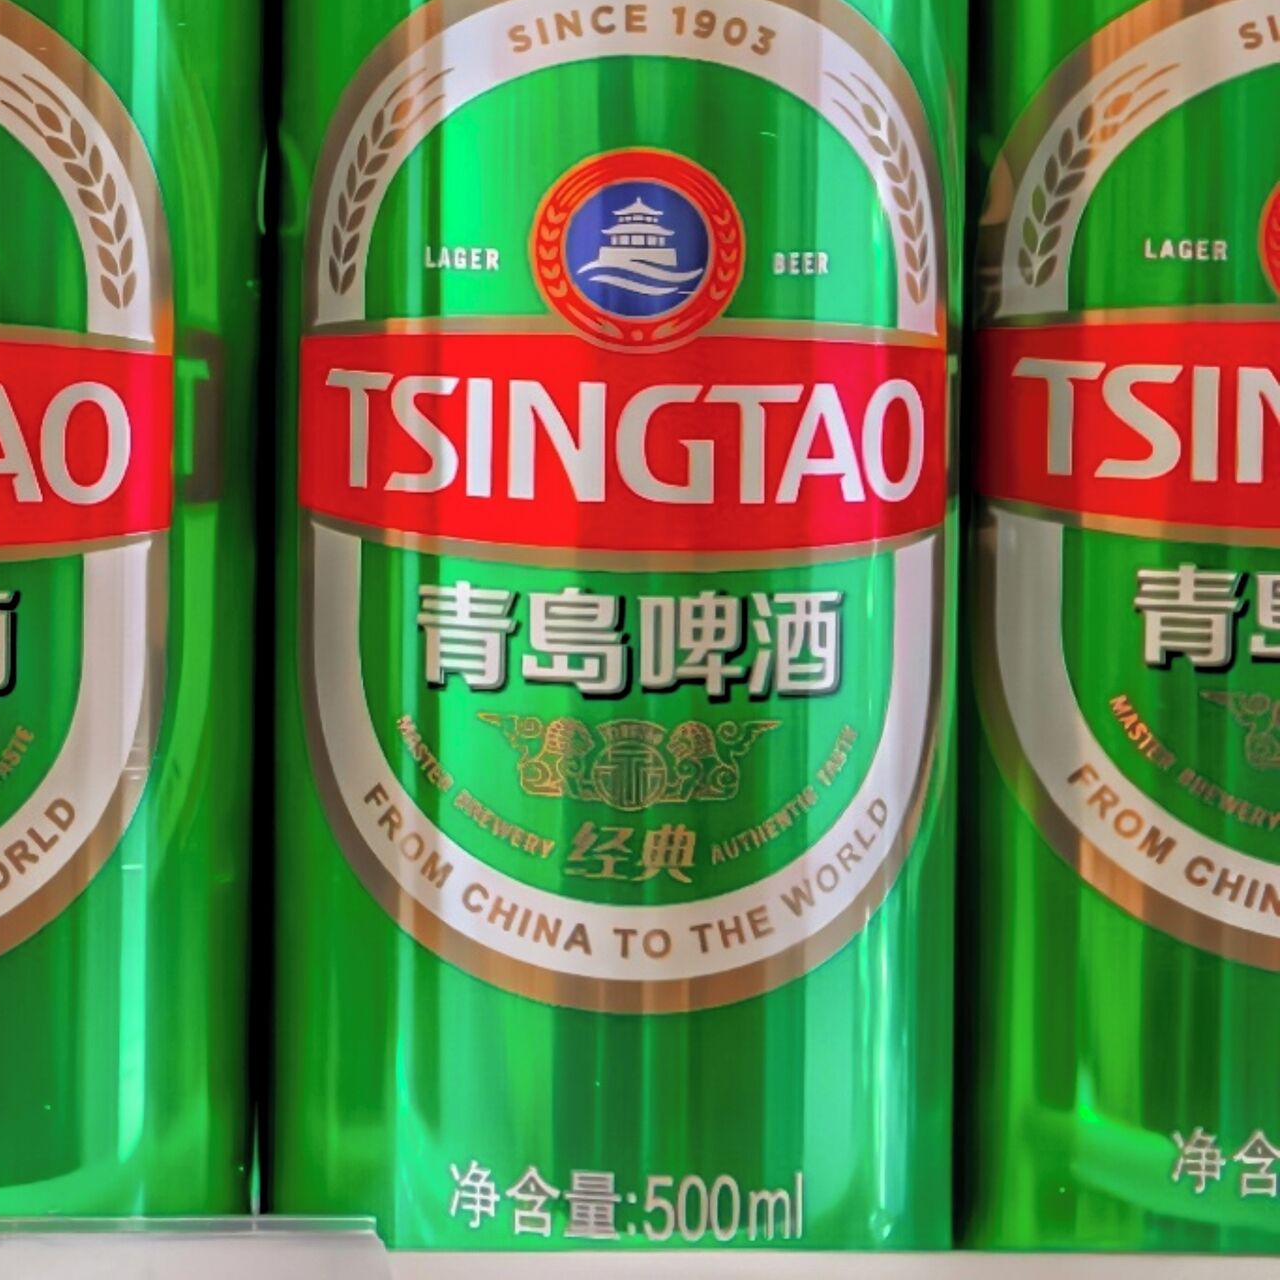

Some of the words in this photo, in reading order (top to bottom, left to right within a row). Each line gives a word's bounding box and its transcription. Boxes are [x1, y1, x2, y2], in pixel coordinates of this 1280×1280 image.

[507, 3, 648, 53] SINCE
[672, 5, 777, 57] 1903
[424, 244, 500, 272] LAGER
[772, 249, 829, 277] BEER
[1143, 237, 1228, 263] LAGER
[324, 367, 925, 505] TSINGTAO
[1067, 762, 1177, 865] FROM
[363, 781, 454, 889] FROM
[461, 882, 593, 957] CHINA
[613, 926, 672, 960] TO
[690, 905, 775, 955] THE
[780, 797, 889, 918] WORLD
[564, 820, 697, 884] 经典
